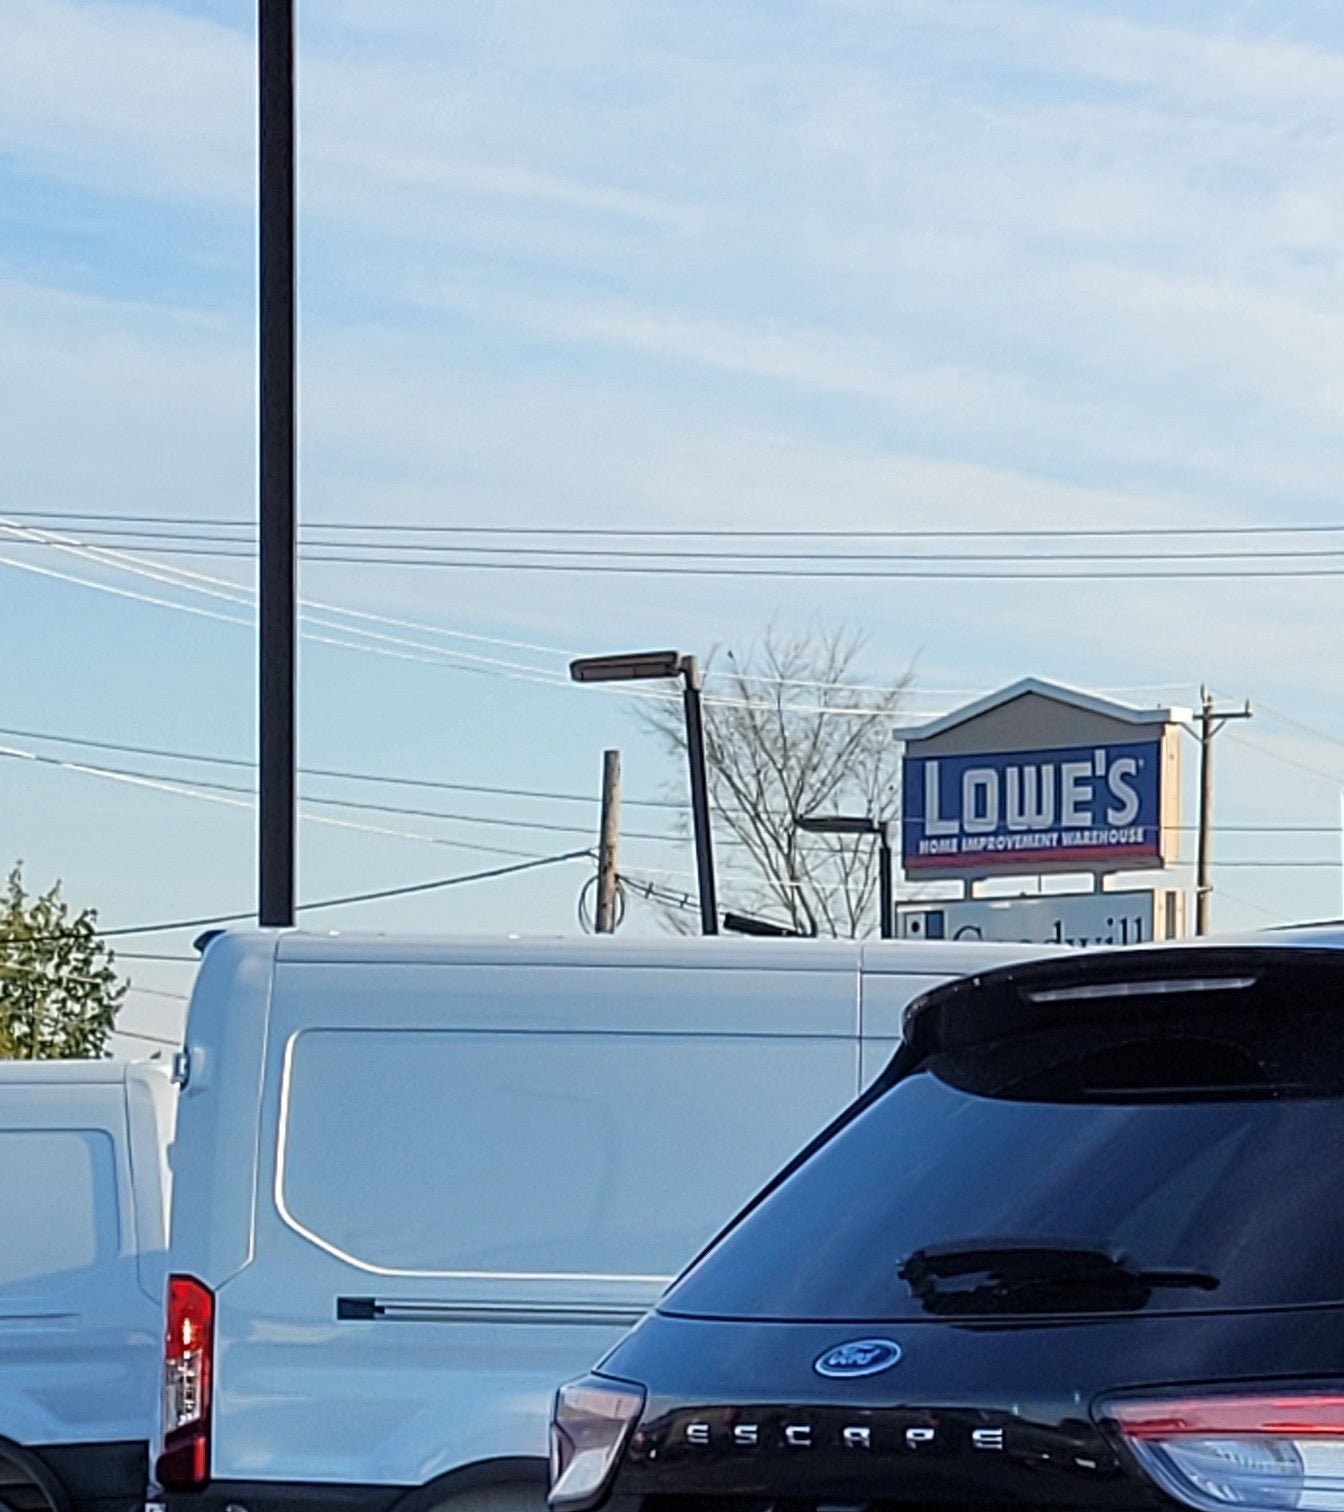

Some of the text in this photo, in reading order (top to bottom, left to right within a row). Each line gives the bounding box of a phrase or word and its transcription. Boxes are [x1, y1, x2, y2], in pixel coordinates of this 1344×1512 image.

[924, 749, 1140, 836] LOWE'S
[919, 827, 1145, 854] HOME IMPROVEMENT WAREHOUSE
[686, 1423, 1003, 1450] ESCAPE
